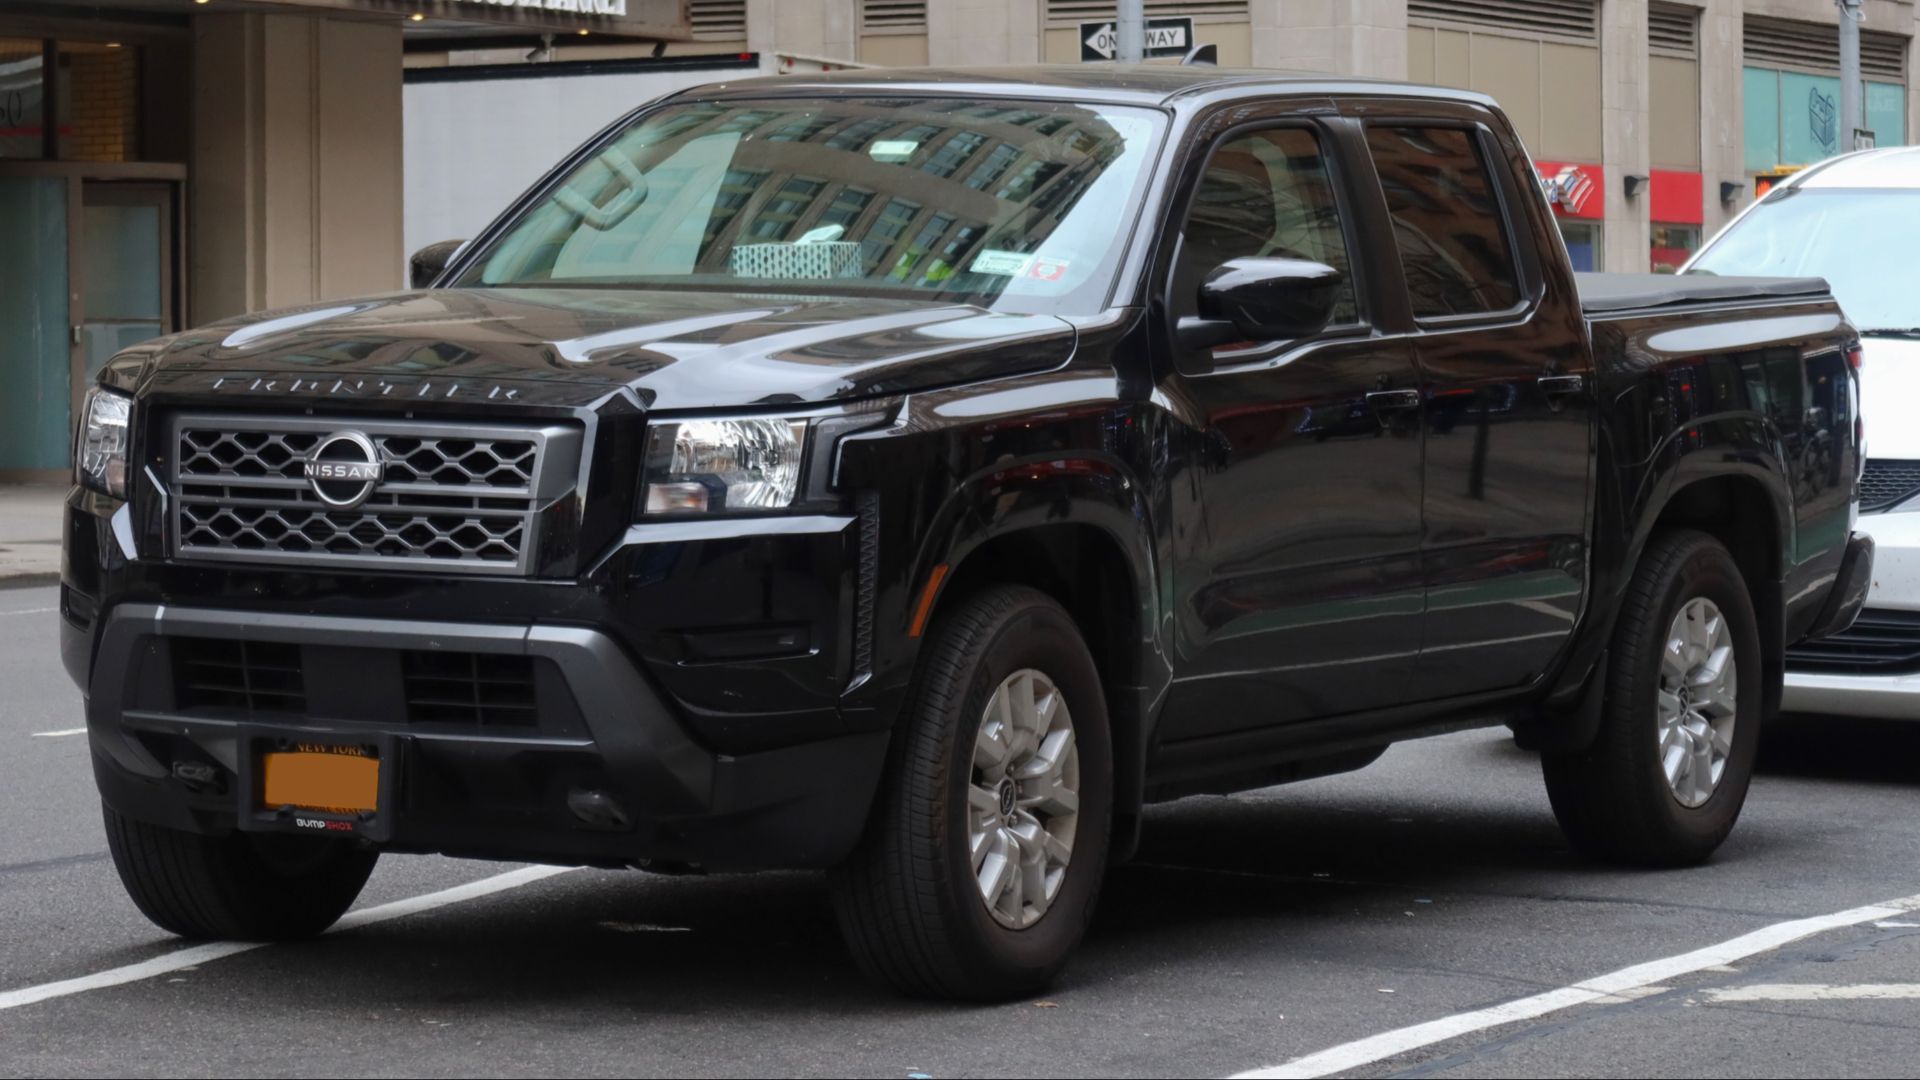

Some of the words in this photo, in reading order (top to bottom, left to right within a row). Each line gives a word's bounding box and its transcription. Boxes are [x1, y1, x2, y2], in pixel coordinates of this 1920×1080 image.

[1097, 33, 1118, 49] ON
[1145, 30, 1178, 47] WAY
[212, 378, 519, 399] FRONTIER
[304, 463, 379, 479] NISSAN
[297, 743, 326, 753] NEW
